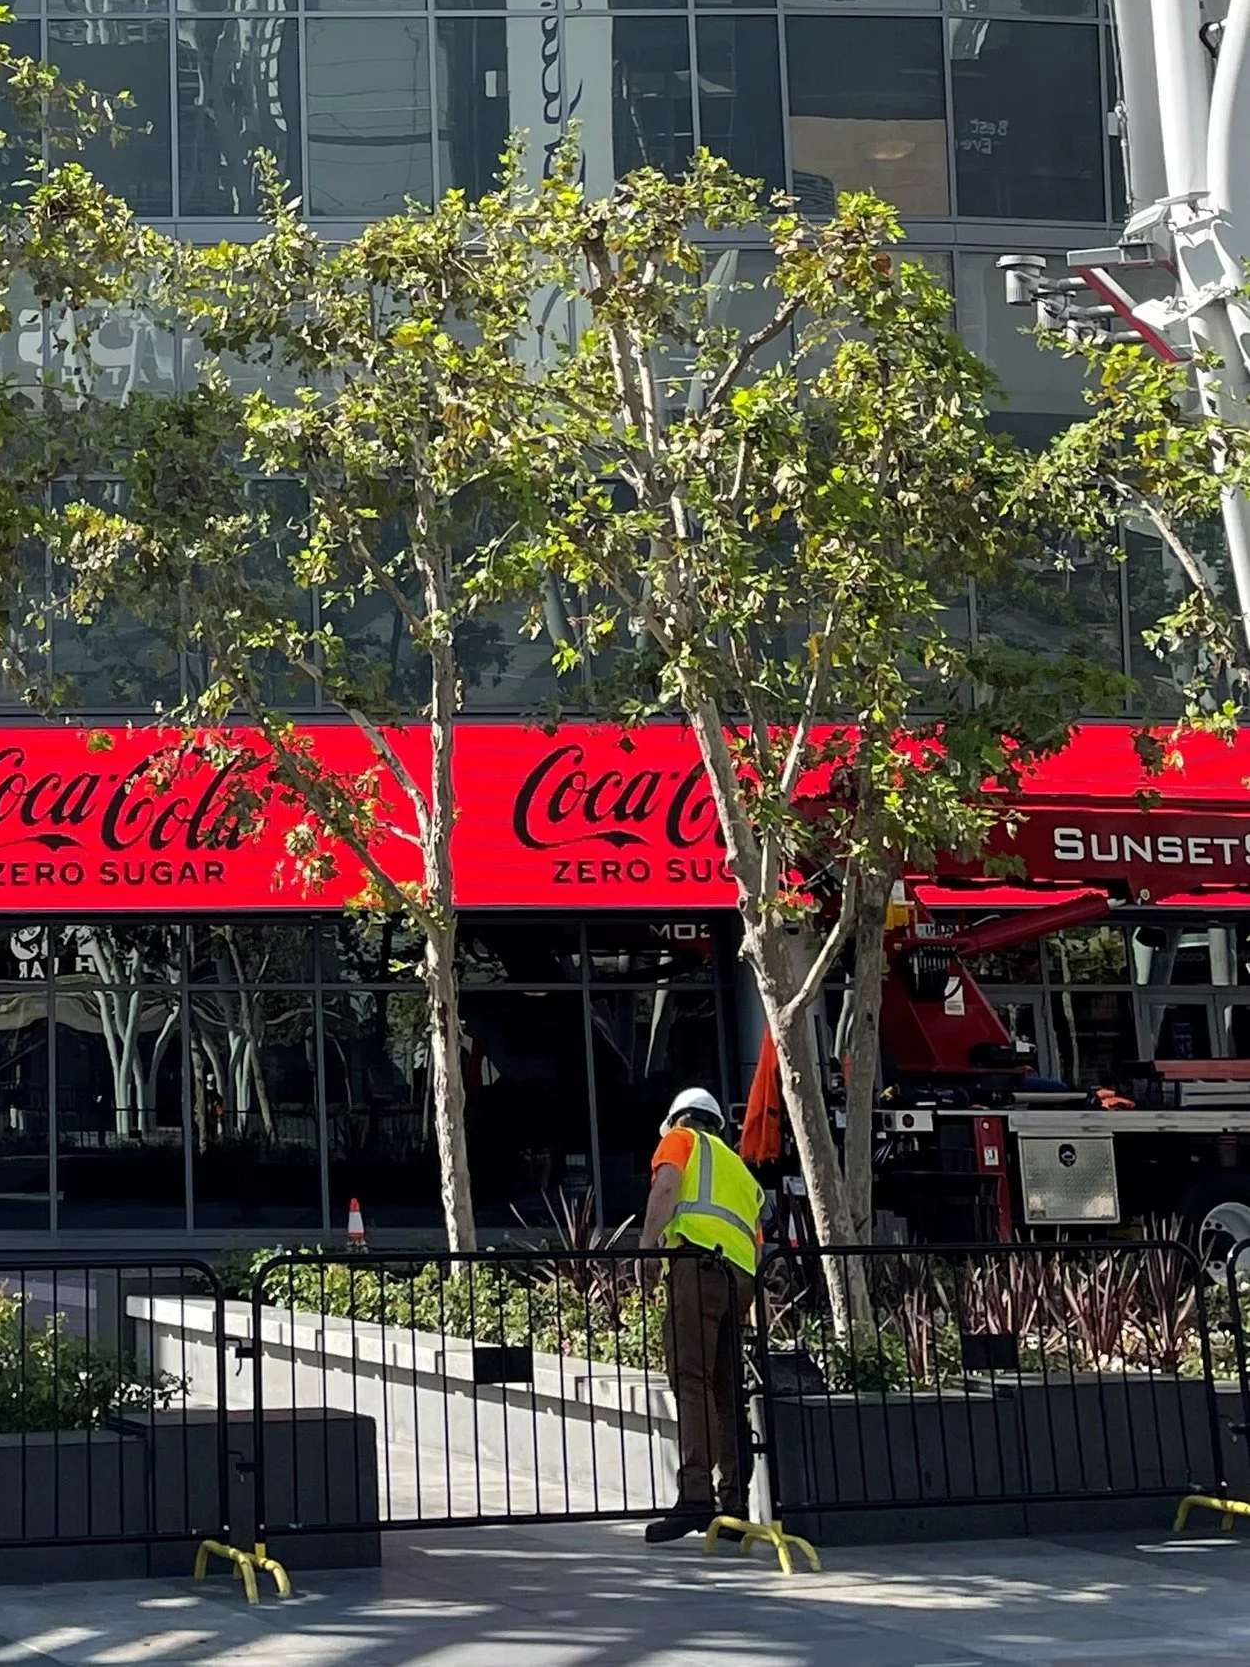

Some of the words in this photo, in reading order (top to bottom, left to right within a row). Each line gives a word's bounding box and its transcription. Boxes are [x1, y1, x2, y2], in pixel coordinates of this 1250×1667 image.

[1053, 827, 1250, 866] SUNSET
[100, 860, 227, 886] SUGAR
[553, 859, 651, 884] ZERO
